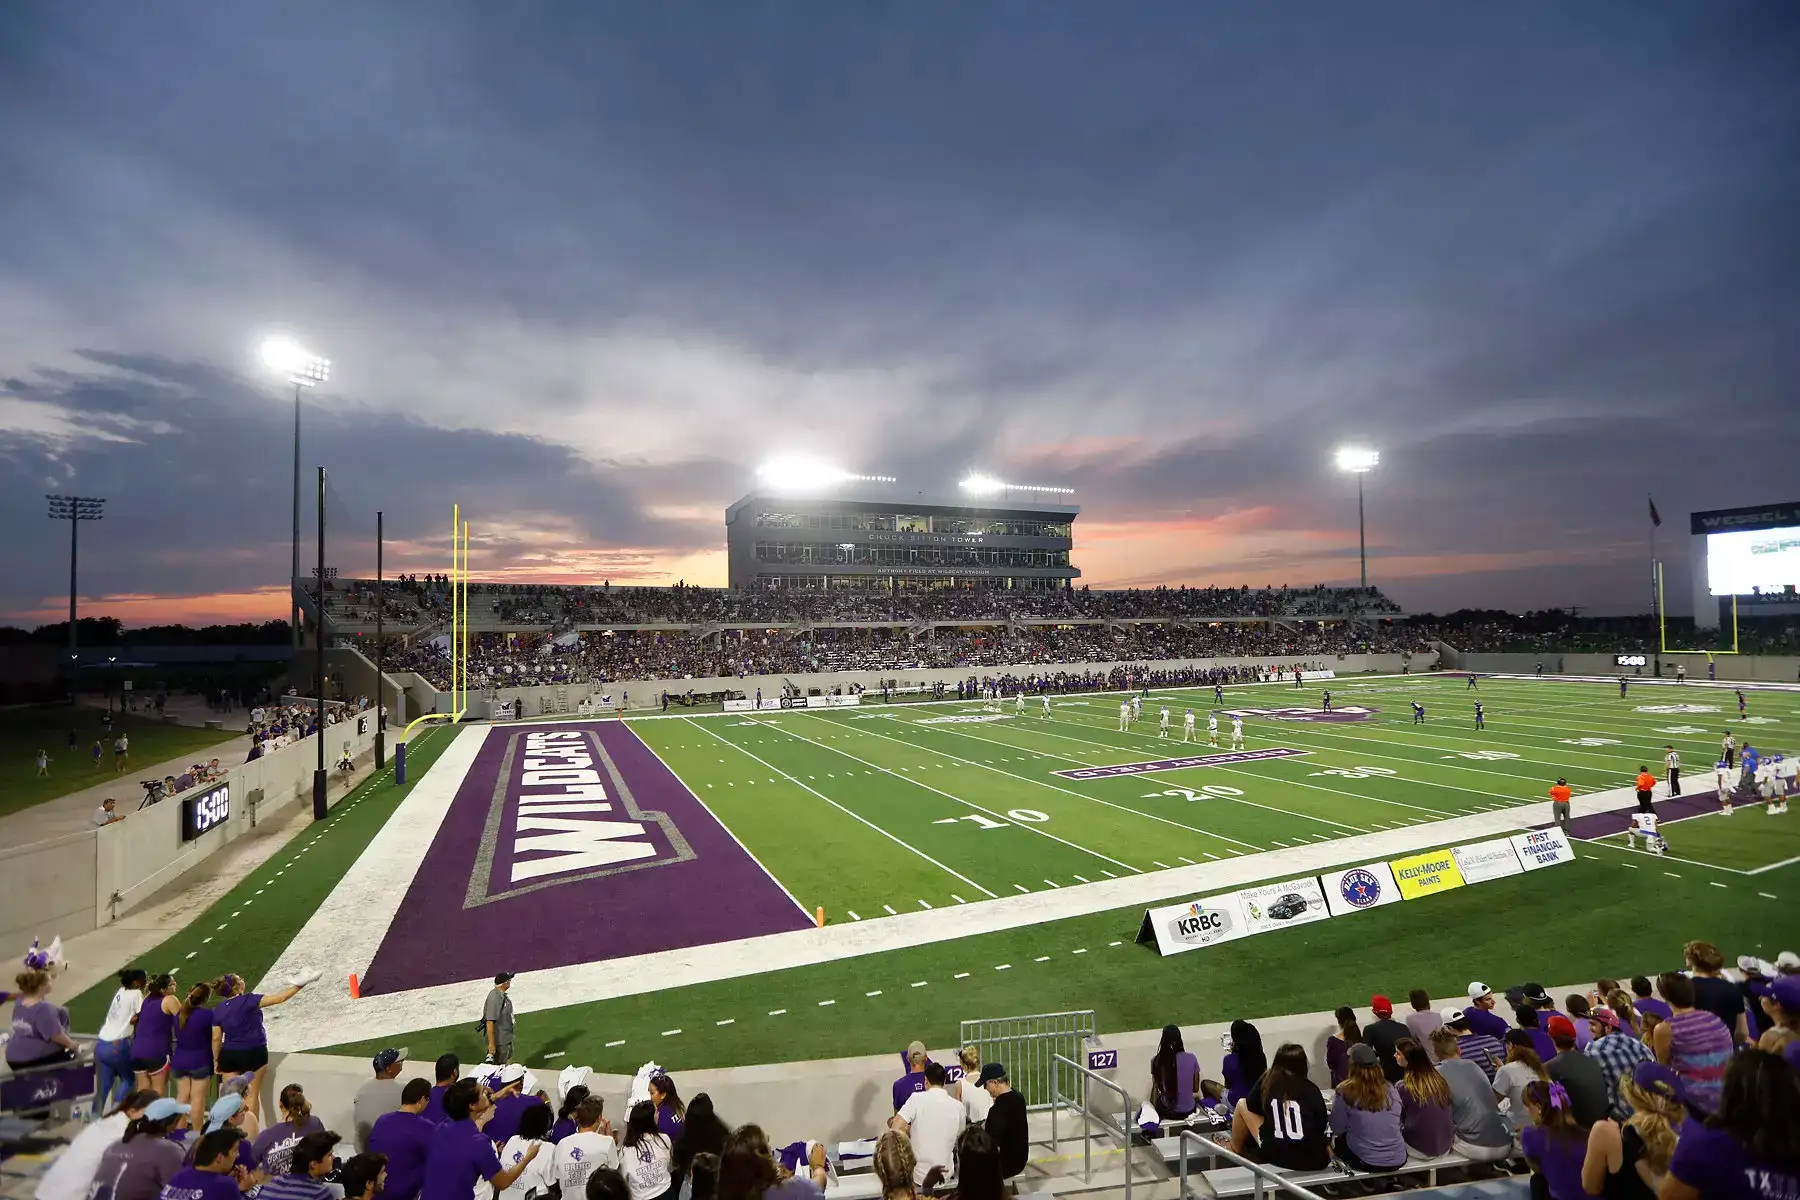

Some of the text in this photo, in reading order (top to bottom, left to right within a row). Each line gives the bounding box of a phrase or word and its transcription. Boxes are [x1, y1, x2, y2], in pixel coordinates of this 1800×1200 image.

[1702, 511, 1788, 526] WESSEL
[1073, 750, 1290, 777] ANTHONY FIELD
[1323, 765, 1397, 778] 30
[1163, 785, 1245, 802] 20
[197, 787, 229, 829] 15:00
[511, 731, 657, 883] WILDCATS
[960, 809, 1050, 829] 10
[1644, 816, 1652, 825] 2
[1526, 832, 1550, 845] FIRST
[1522, 840, 1563, 856] FINANCIAL
[1535, 851, 1560, 864] BANK
[1398, 860, 1451, 880] KELLY-MOORE
[1344, 873, 1375, 891] BLUE SKY
[1418, 874, 1441, 887] PAINTS
[1240, 892, 1258, 900] Make
[1258, 887, 1277, 896] Yours
[1177, 913, 1222, 936] KRBC
[1091, 1053, 1115, 1067] 127
[1270, 1098, 1305, 1140] 10
